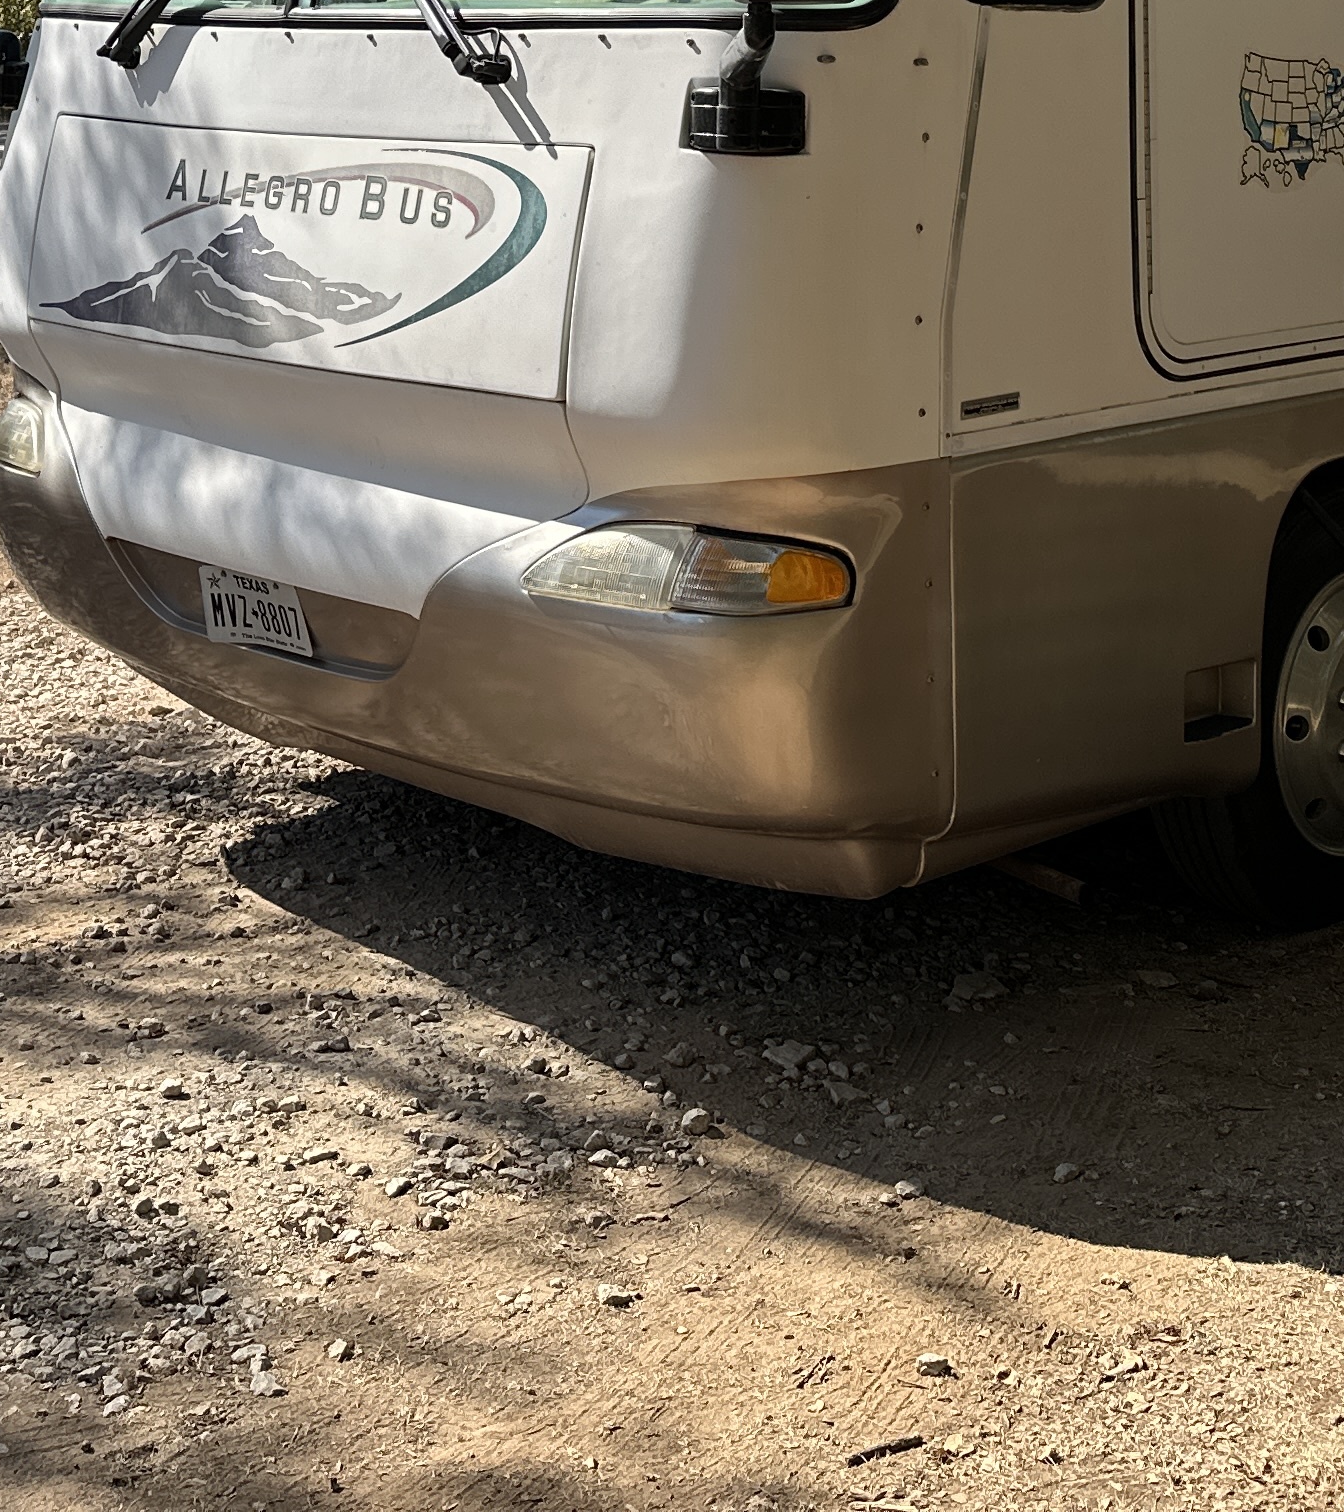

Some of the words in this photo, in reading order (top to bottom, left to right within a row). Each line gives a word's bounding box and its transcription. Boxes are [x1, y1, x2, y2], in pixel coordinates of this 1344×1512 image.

[165, 158, 341, 217] ALLEGRO
[359, 175, 454, 229] BUS
[233, 574, 270, 595] TEXAS
